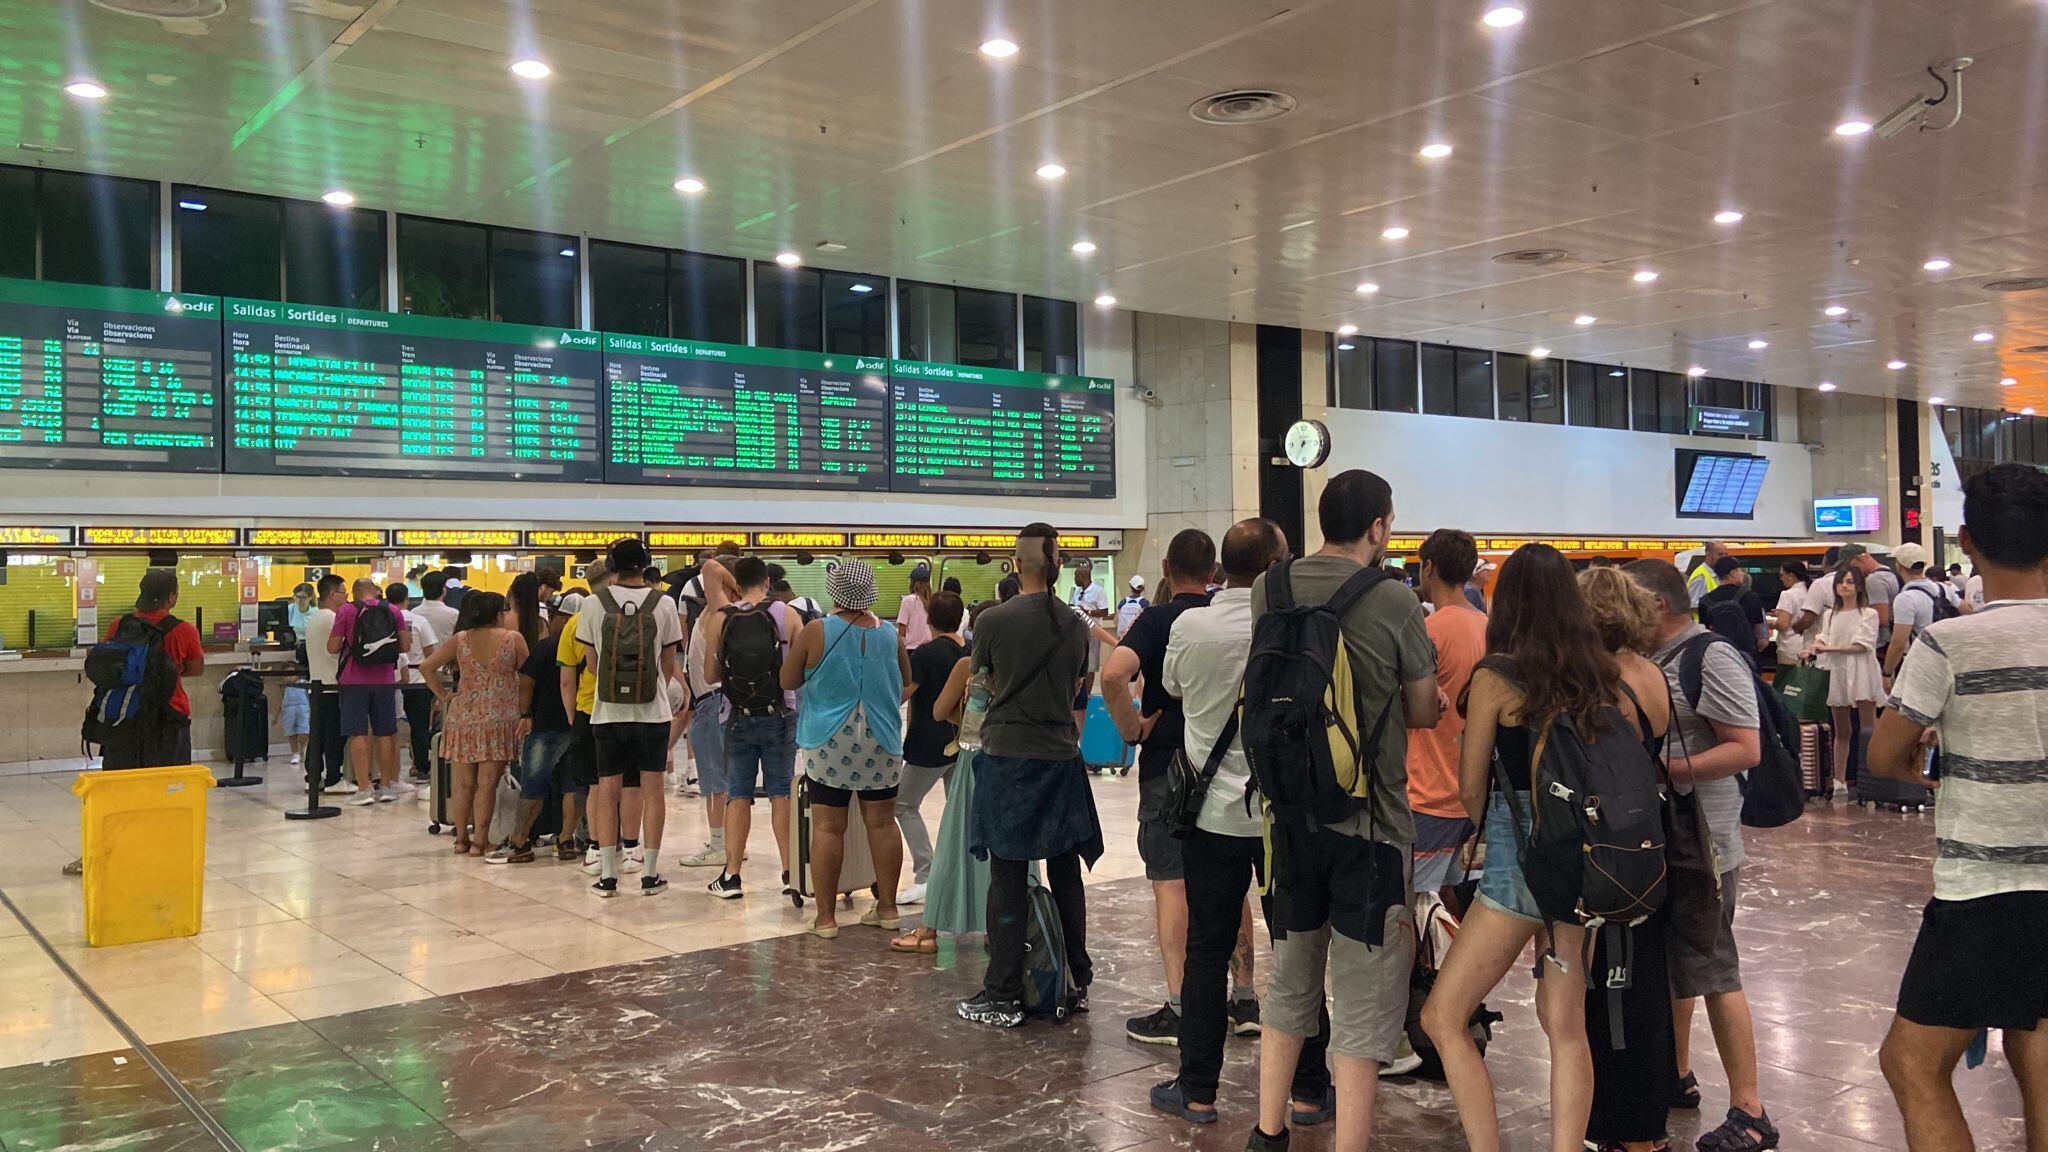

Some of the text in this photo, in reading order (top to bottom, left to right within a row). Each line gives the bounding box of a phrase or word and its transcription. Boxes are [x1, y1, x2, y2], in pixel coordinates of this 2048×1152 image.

[182, 301, 215, 312] adif
[233, 304, 389, 328] Salidas Sortides DEPARTURES
[103, 322, 156, 333] Observaciones
[103, 330, 153, 340] Observacions
[232, 331, 249, 339] Hora
[274, 335, 300, 343] Destino
[232, 338, 250, 346] Hora
[572, 336, 597, 345] adif
[274, 341, 310, 351] Destinació
[609, 338, 642, 350] Salidas
[650, 342, 688, 354] Sortides
[514, 354, 553, 363] Observaciones
[514, 360, 551, 369] Observacions
[865, 361, 885, 370] adif
[640, 371, 667, 379] Destinació
[894, 364, 920, 374] Salidas
[924, 366, 954, 377] Sortides
[150, 529, 179, 537] MITJA
[311, 530, 335, 538] MEDIA
[337, 531, 378, 539] DISTANCIA
[435, 531, 469, 539] TRAIN
[473, 531, 518, 539] TICKETS
[1003, 563, 1008, 571] 9
[311, 567, 323, 582] 3
[575, 566, 586, 578] 5
